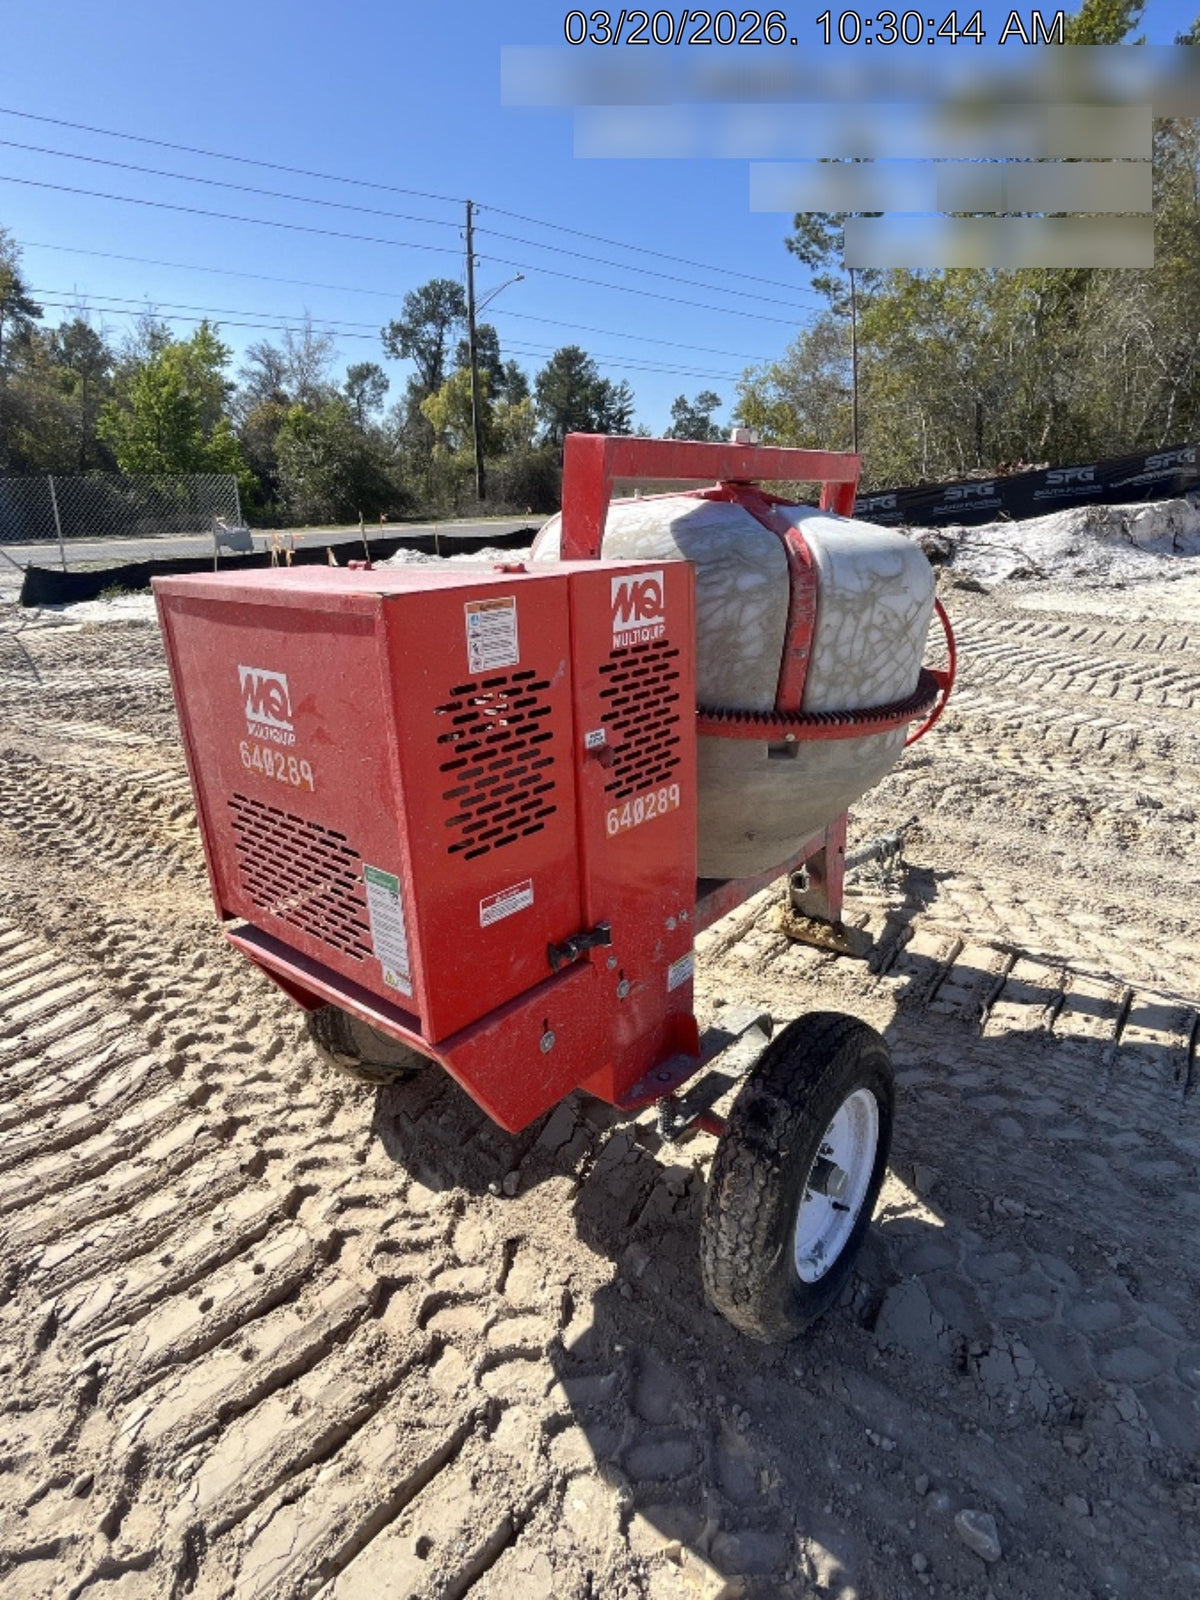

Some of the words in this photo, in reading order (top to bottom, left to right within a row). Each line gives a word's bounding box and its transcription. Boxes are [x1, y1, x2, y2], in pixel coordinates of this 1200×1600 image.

[612, 624, 665, 650] MULTIQUIP
[240, 741, 315, 792] 640289
[606, 783, 680, 835] 640289
